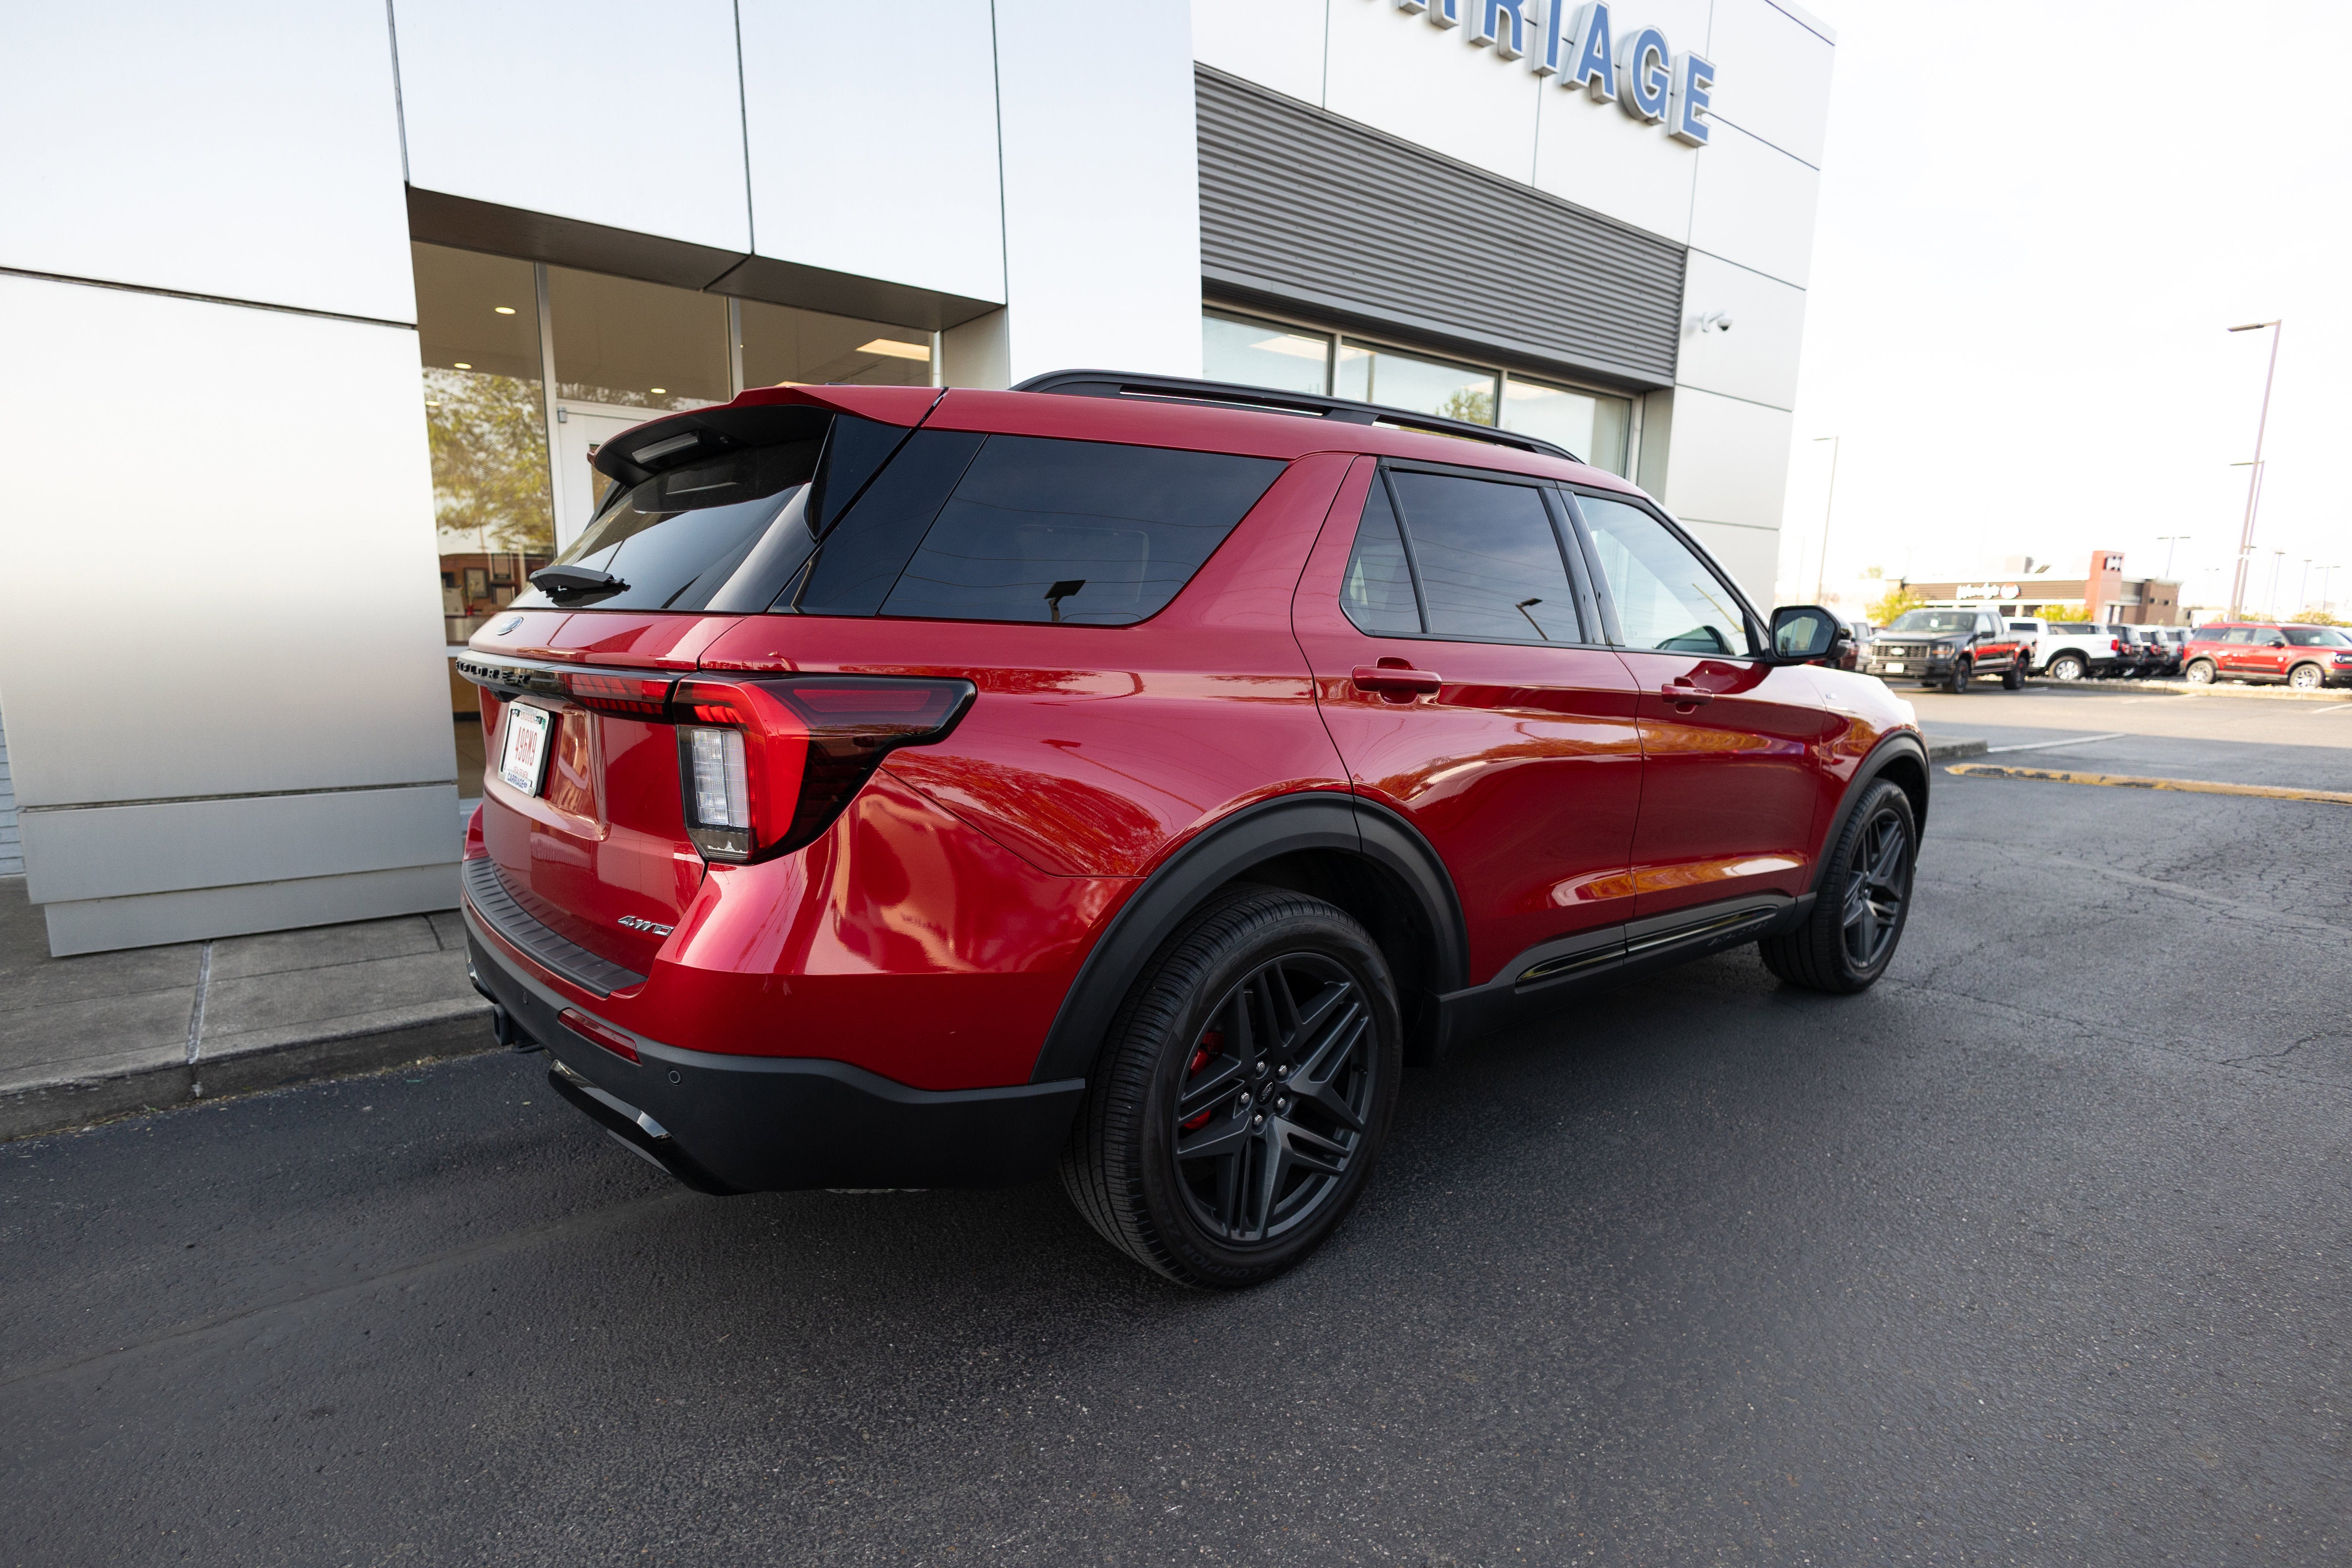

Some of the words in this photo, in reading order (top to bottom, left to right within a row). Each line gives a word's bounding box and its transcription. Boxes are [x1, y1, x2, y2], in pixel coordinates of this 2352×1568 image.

[1399, 0, 1716, 147] RIAGE
[515, 726, 537, 766] 496M9
[507, 772, 524, 788] CARRIAGE
[618, 915, 675, 936] 4WD
